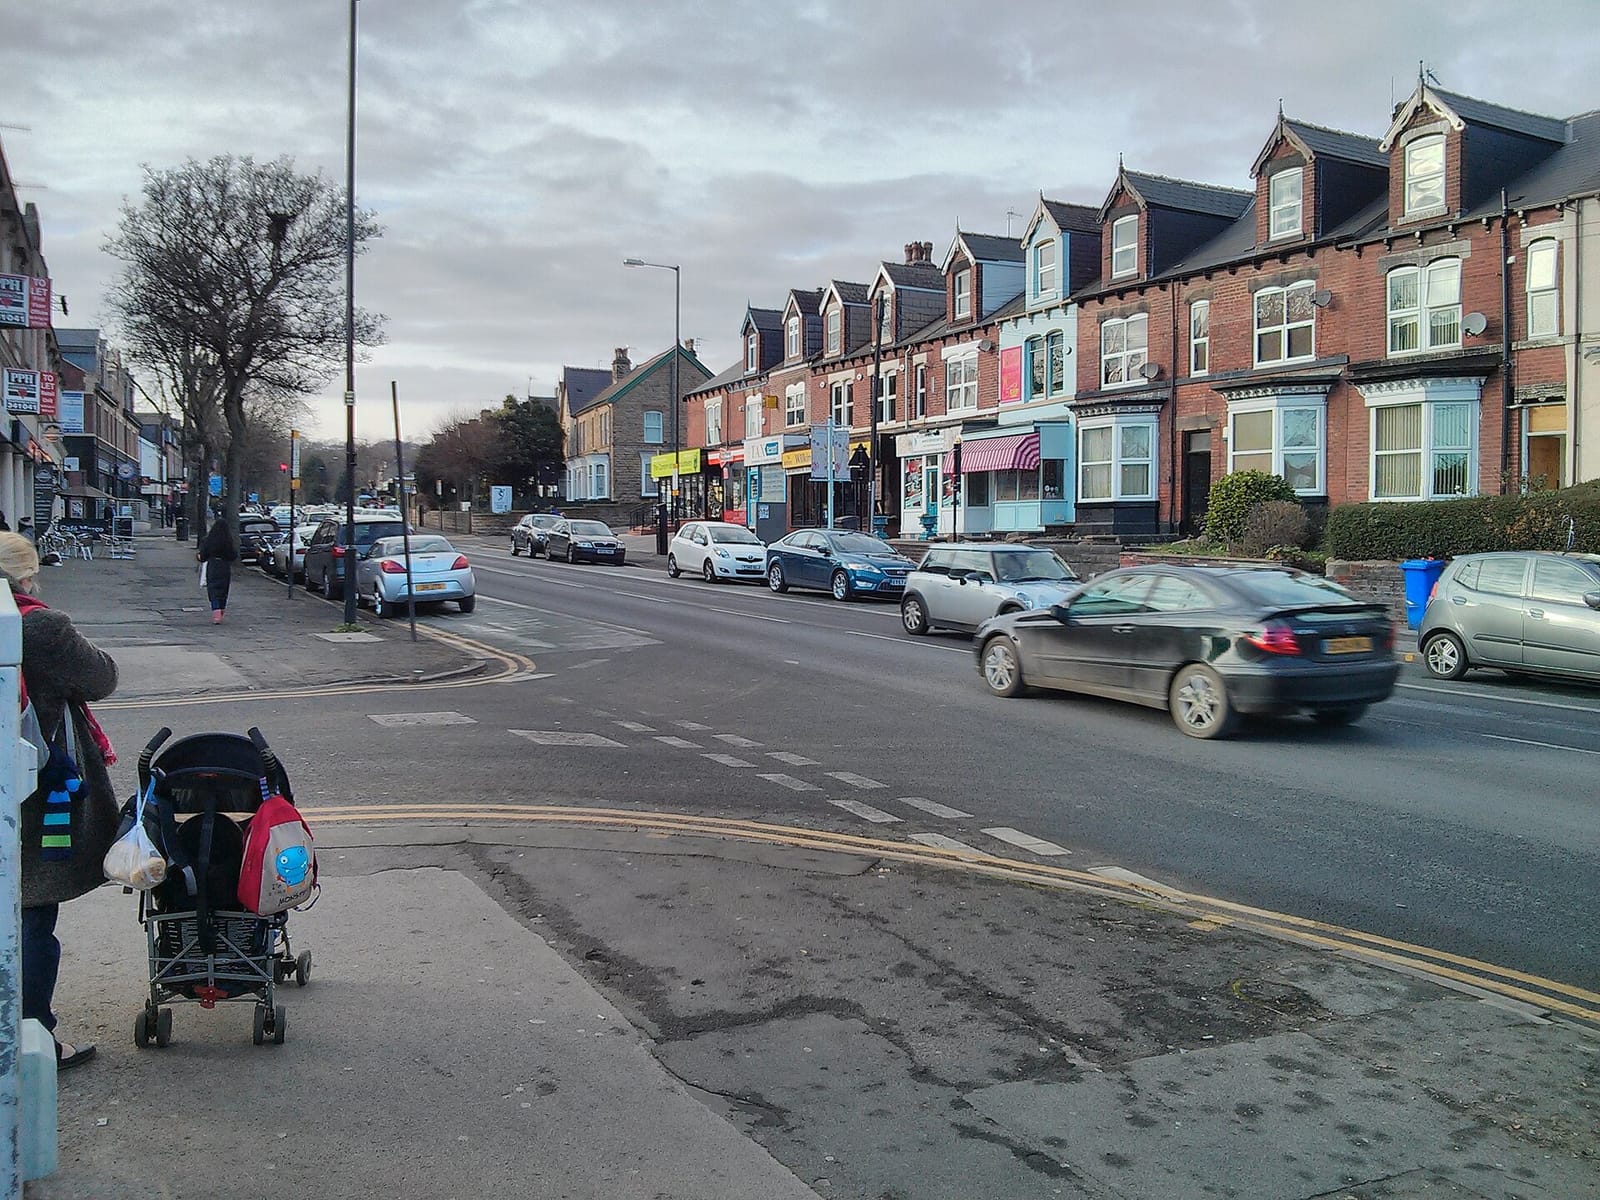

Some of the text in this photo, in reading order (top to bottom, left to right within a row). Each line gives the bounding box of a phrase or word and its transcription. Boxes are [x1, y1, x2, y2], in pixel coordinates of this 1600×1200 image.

[0, 278, 20, 291] PH
[32, 278, 46, 287] TO
[31, 287, 48, 296] LET
[10, 372, 34, 384] PPH
[42, 373, 54, 382] TO
[40, 382, 56, 390] LET
